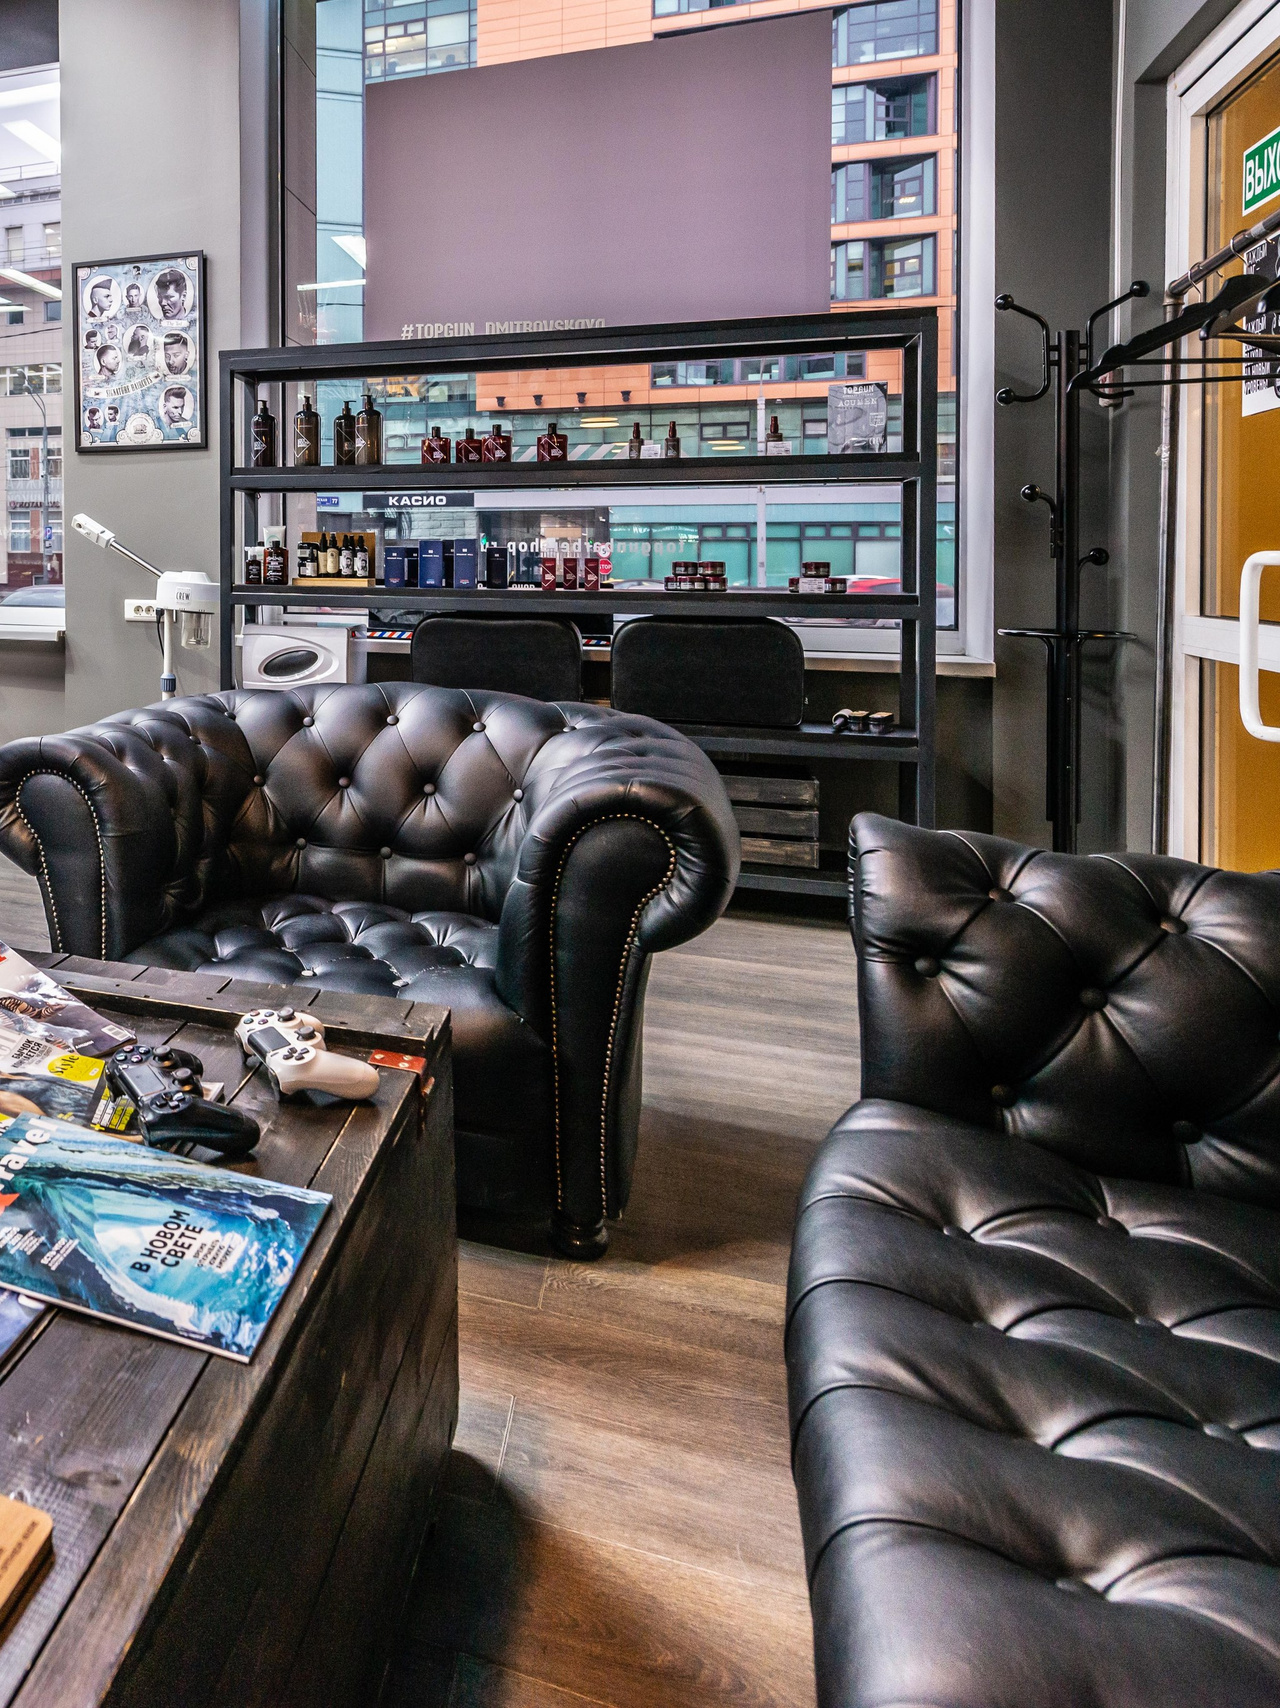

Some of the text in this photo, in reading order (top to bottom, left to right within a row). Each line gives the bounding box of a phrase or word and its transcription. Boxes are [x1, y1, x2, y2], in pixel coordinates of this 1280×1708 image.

[388, 495, 447, 506] КАСИО
[176, 591, 190, 600] CREW
[49, 1055, 79, 1075] Style
[130, 1210, 190, 1273] В НОВОМ
[161, 1224, 204, 1267] СВЕТЕ
